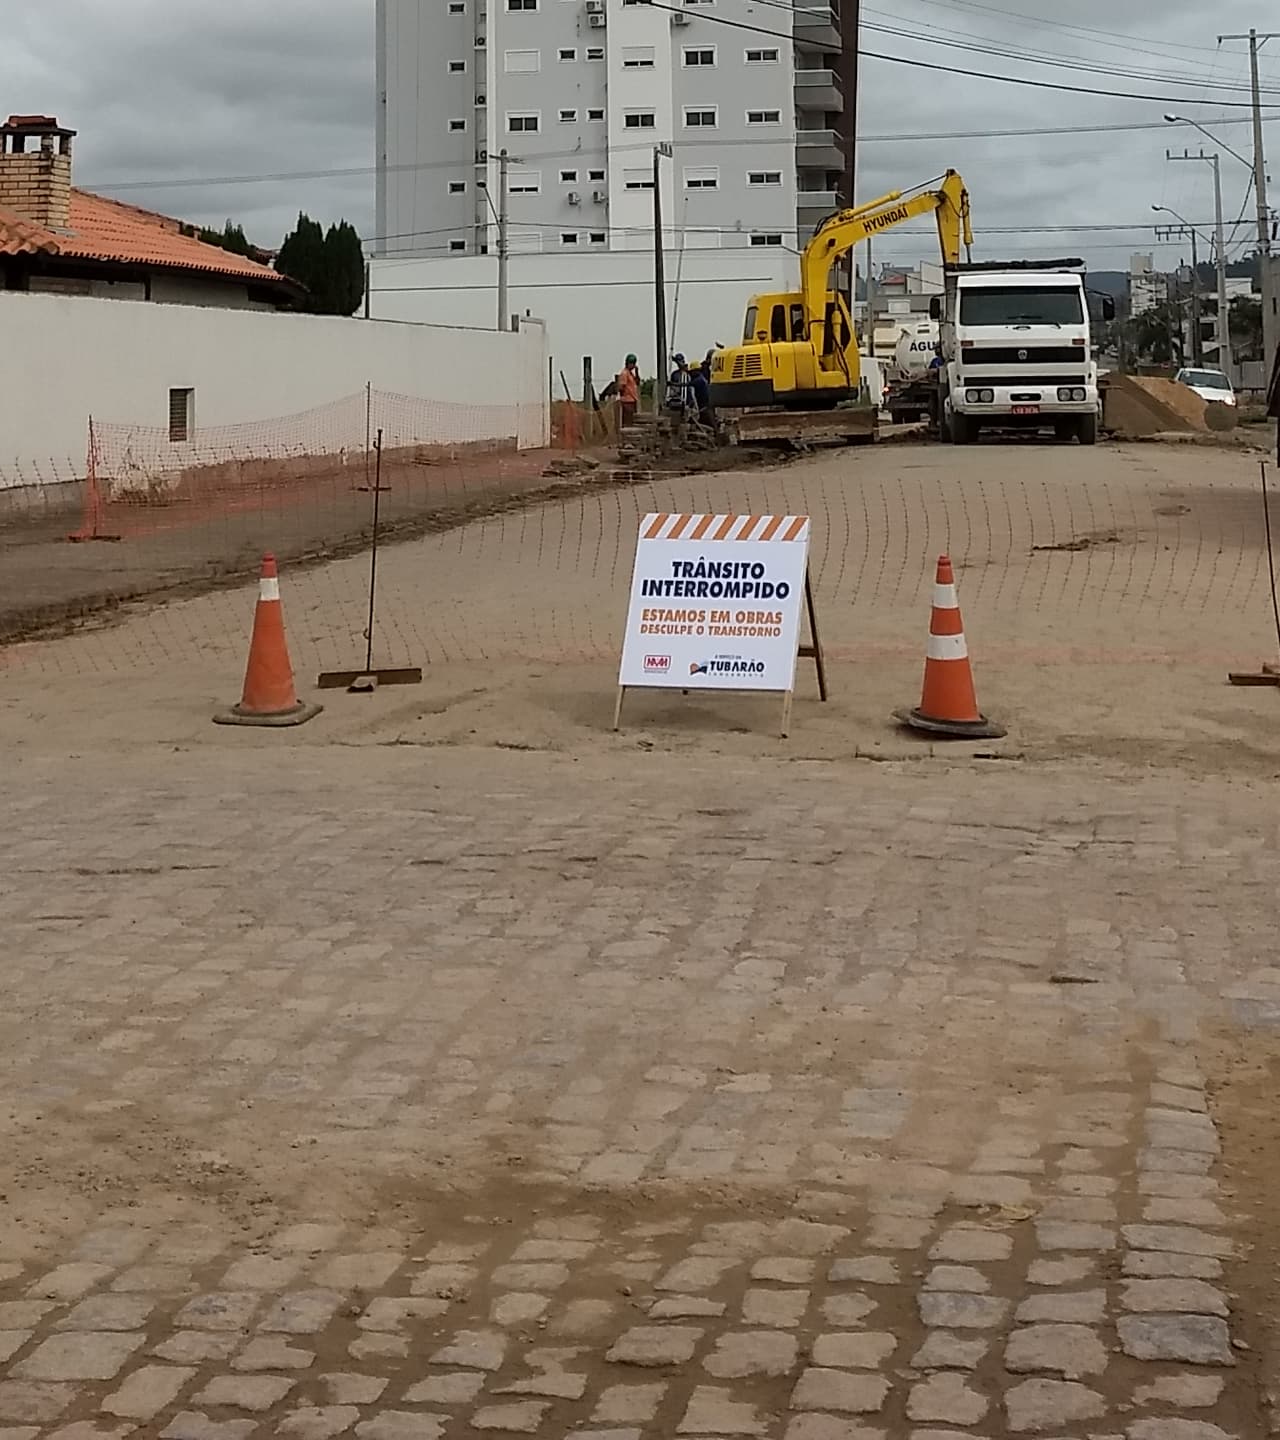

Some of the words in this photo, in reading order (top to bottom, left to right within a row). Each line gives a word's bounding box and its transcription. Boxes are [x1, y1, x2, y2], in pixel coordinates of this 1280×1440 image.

[862, 207, 909, 232] HYUNDAI
[909, 339, 938, 352] ÁGU
[672, 556, 765, 580] TRÂNSITO
[641, 579, 790, 600] INTERROMPIDO
[641, 609, 706, 624] ESTAMOS
[710, 610, 731, 624] EM
[735, 611, 783, 625] OBRAS
[640, 625, 693, 635] DESCULPE
[696, 626, 705, 636] O
[708, 626, 781, 637] TRANSTORNO
[710, 659, 765, 673] TUBARÃO
